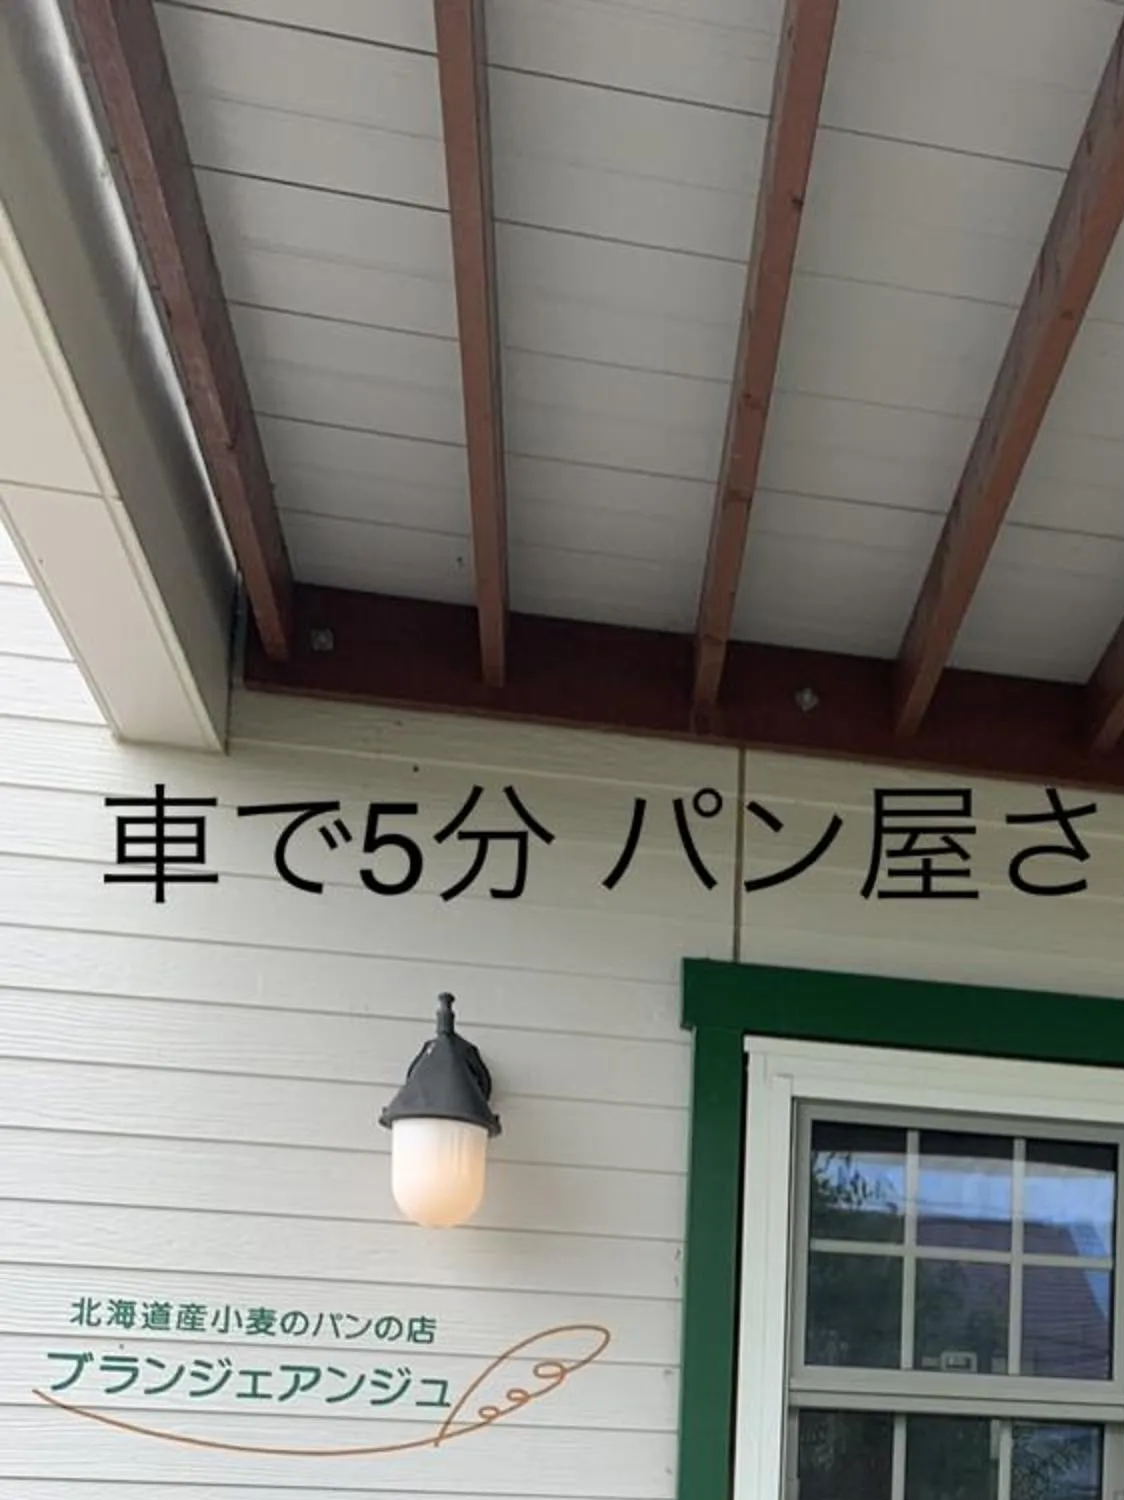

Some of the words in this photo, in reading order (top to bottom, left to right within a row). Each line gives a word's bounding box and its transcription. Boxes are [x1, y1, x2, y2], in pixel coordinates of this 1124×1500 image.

[70, 1297, 437, 1344] 北海道産小麦のパンの店
[47, 1351, 452, 1408] ブランジェアンジュ
